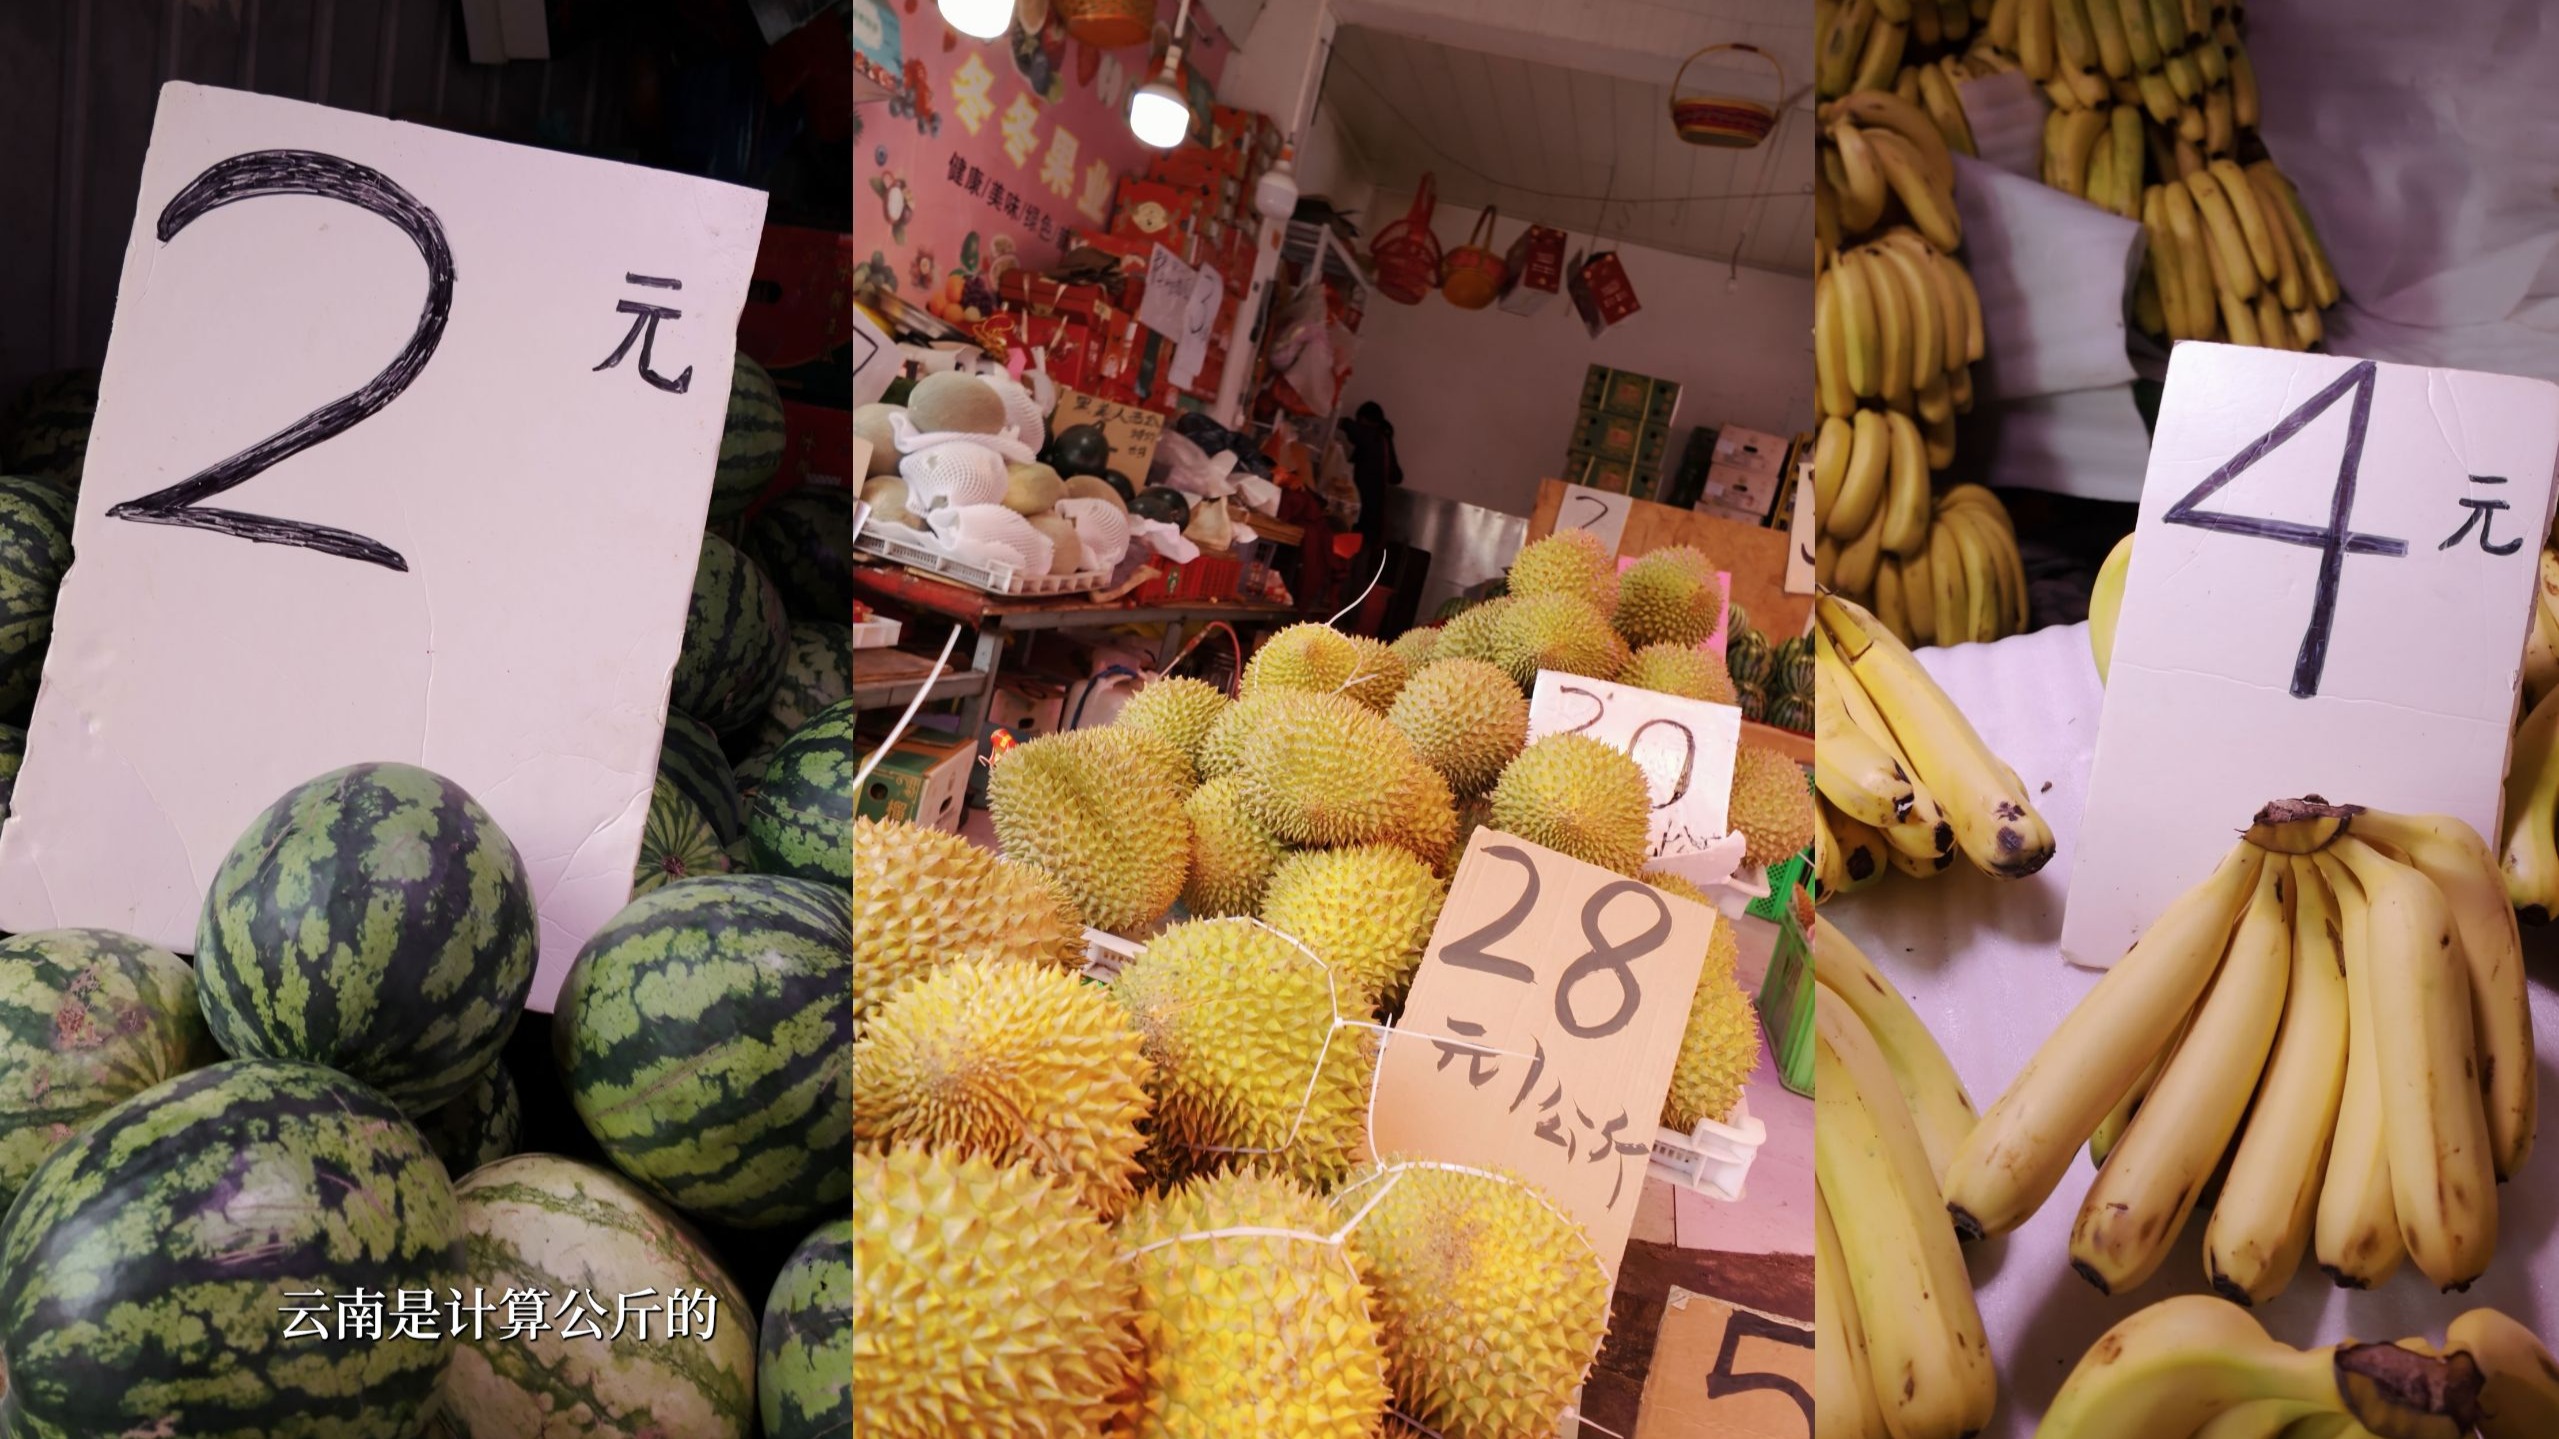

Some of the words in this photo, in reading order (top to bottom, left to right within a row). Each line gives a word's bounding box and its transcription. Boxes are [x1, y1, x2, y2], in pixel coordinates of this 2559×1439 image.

[105, 148, 458, 573] 2
[593, 271, 693, 394] 元
[2161, 359, 2409, 699] 4
[2438, 474, 2523, 556] 元
[1438, 844, 1673, 1040] 28
[1430, 1014, 1650, 1211] 元/公斤
